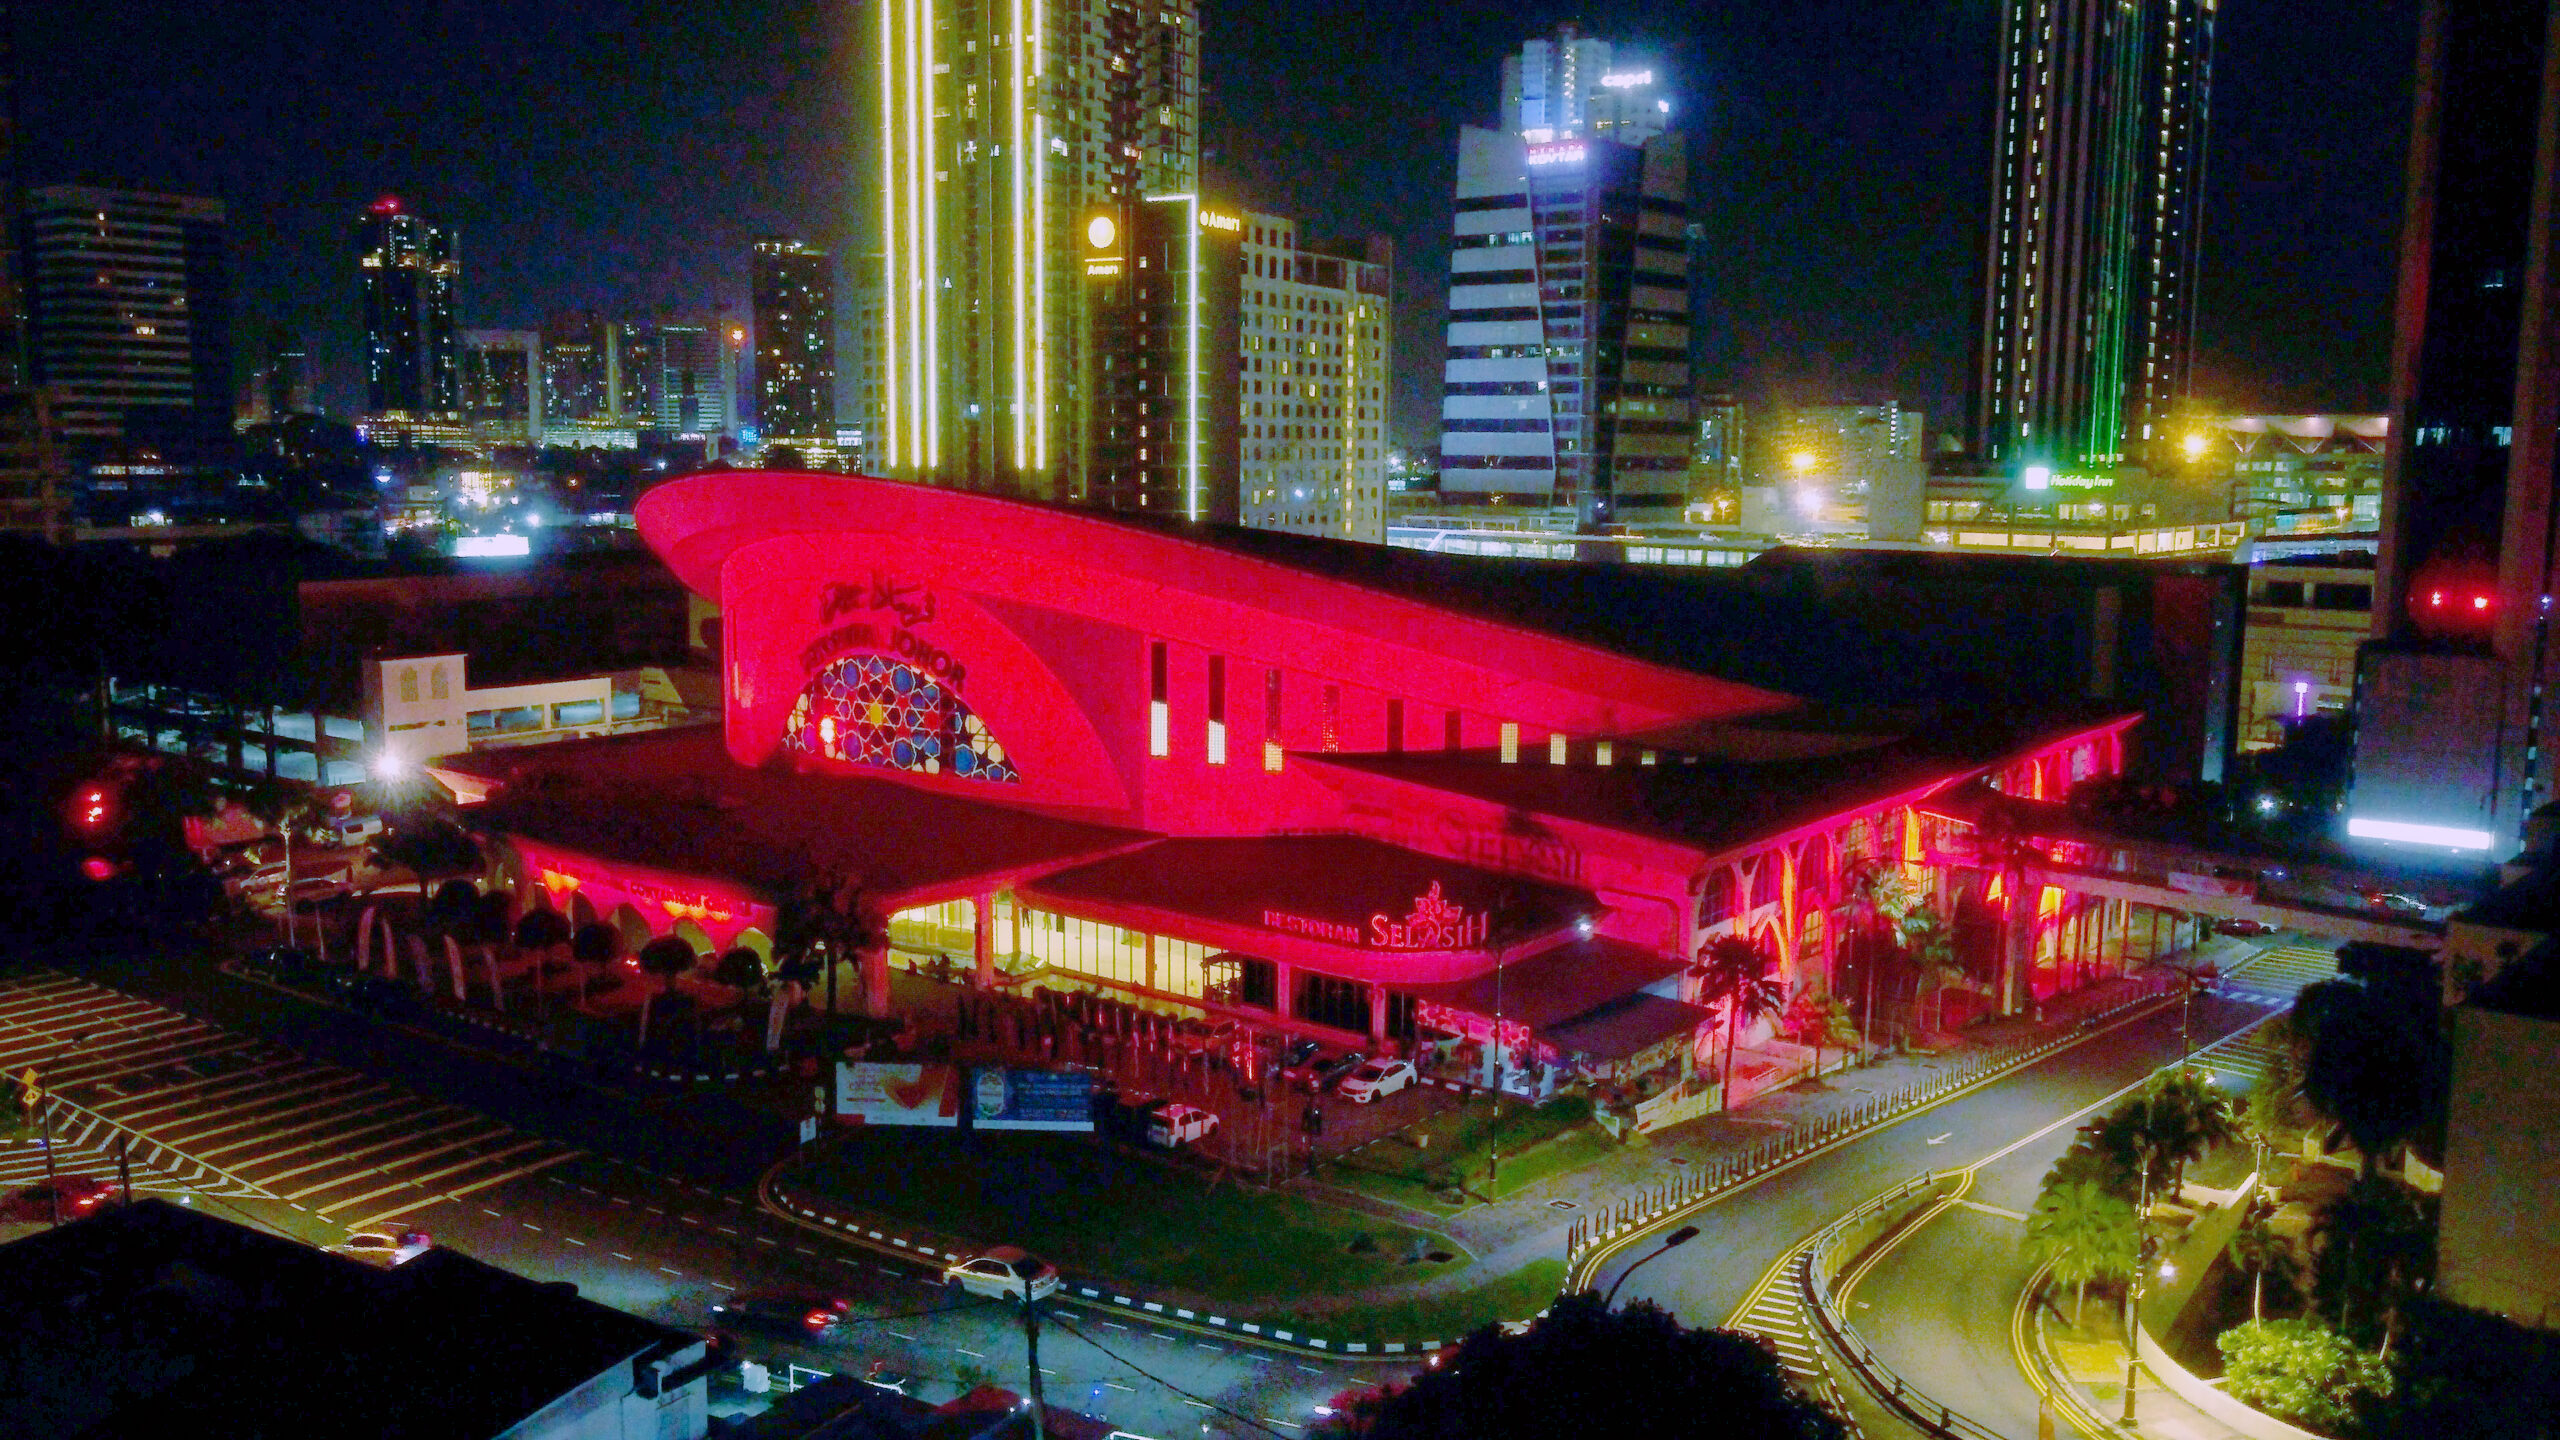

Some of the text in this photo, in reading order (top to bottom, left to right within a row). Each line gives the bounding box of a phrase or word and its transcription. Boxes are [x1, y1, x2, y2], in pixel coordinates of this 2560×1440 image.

[2050, 474, 2113, 489] Holiday Inn
[1264, 910, 1487, 948] RESTORAN SELASIH
